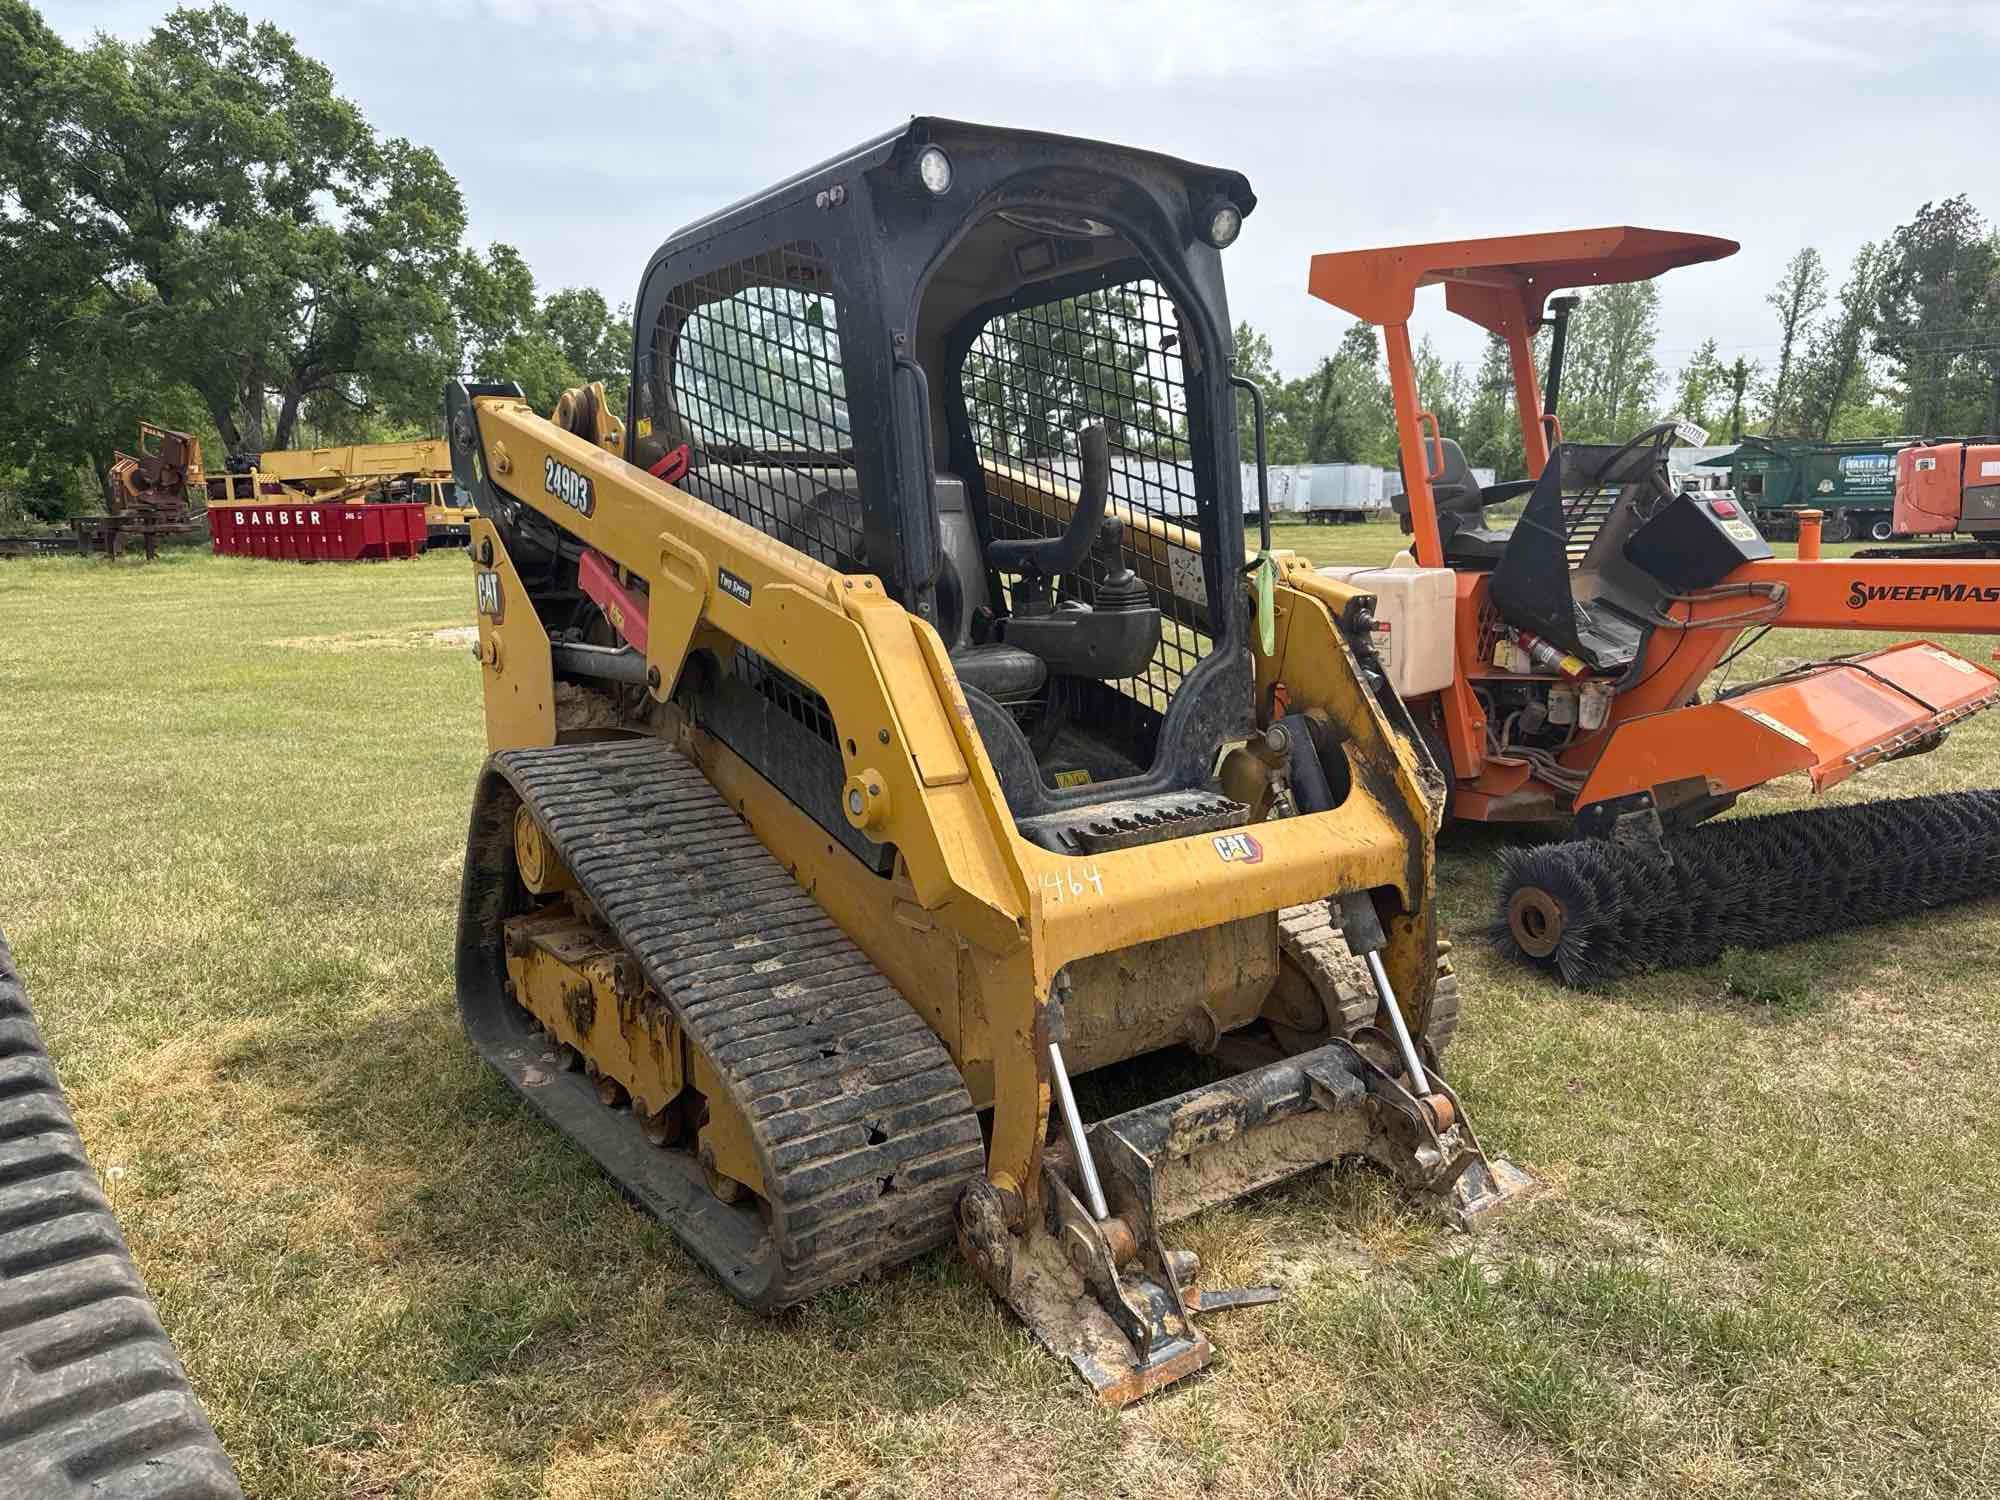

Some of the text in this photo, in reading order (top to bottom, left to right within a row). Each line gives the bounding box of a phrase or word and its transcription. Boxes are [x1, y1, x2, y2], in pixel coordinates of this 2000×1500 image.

[545, 457, 588, 513] 249D3
[235, 511, 320, 525] BARBER
[477, 574, 498, 613] CAT
[1214, 834, 1254, 861] CAT
